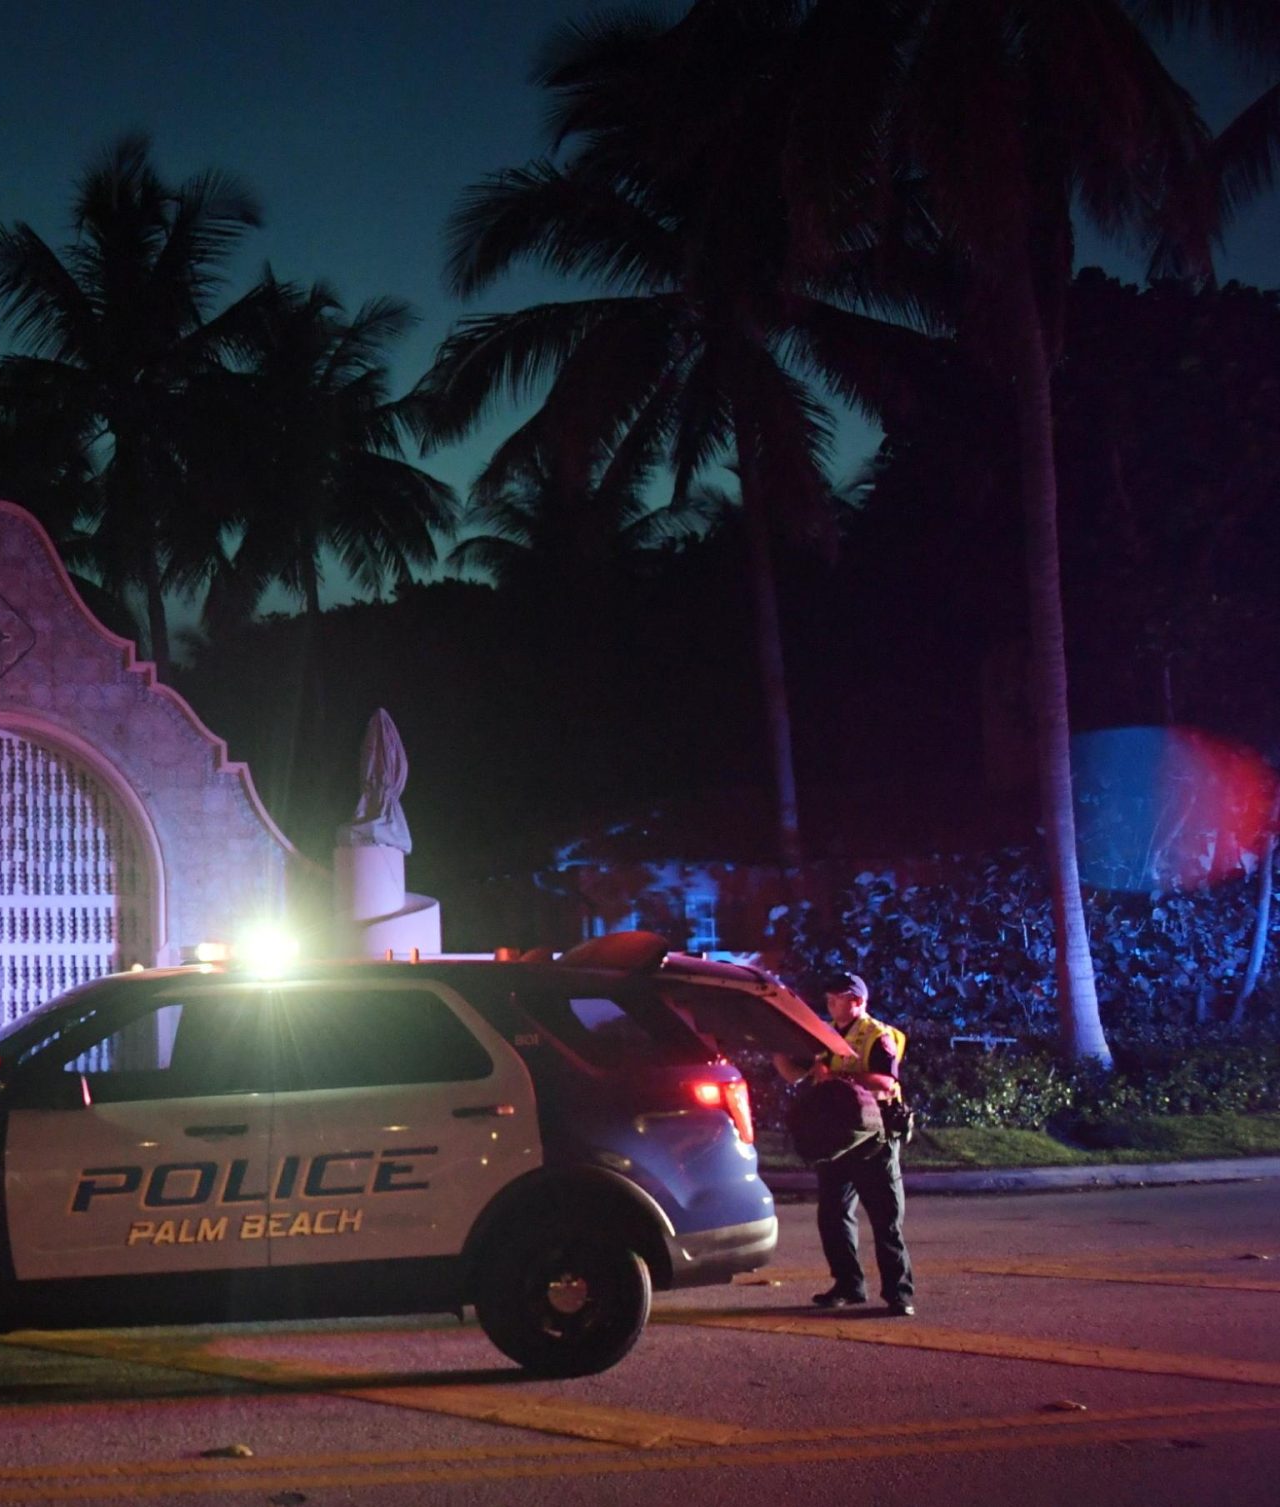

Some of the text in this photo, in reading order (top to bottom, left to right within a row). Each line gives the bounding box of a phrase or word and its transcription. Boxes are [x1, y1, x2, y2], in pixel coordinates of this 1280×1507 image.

[71, 1146, 438, 1213] POLICE
[127, 1208, 363, 1246] PALM BEACH
